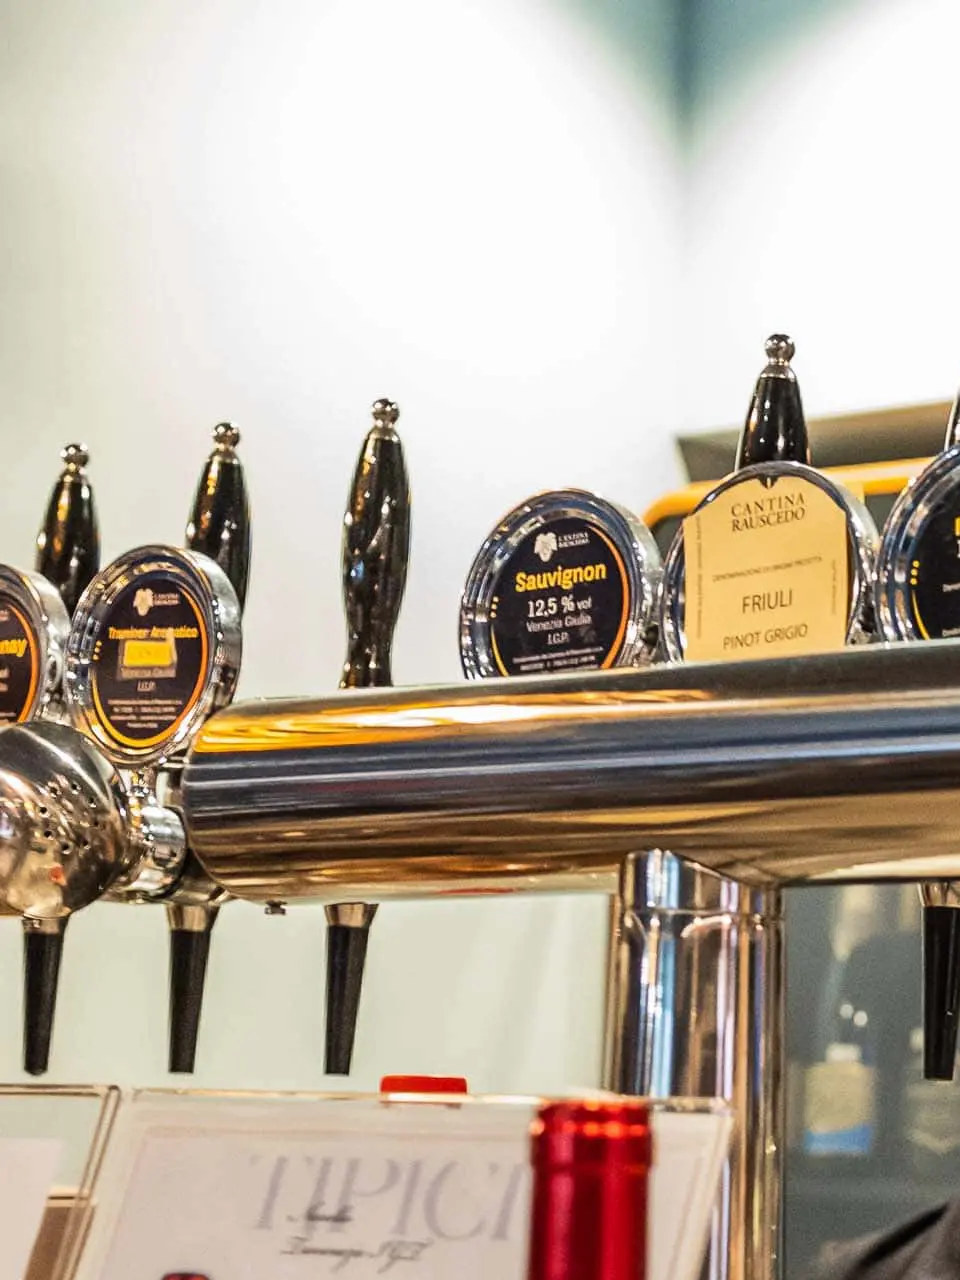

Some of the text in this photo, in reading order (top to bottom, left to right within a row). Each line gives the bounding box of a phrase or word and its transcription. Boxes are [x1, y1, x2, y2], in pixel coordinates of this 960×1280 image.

[731, 492, 806, 518] CANTINA
[731, 507, 806, 532] RAUSCEDO
[515, 563, 608, 592] Sauvignon
[561, 594, 576, 613] %
[577, 597, 592, 610] vol
[742, 590, 794, 615] FRIULI
[723, 623, 809, 650] PINOT GRIGIO
